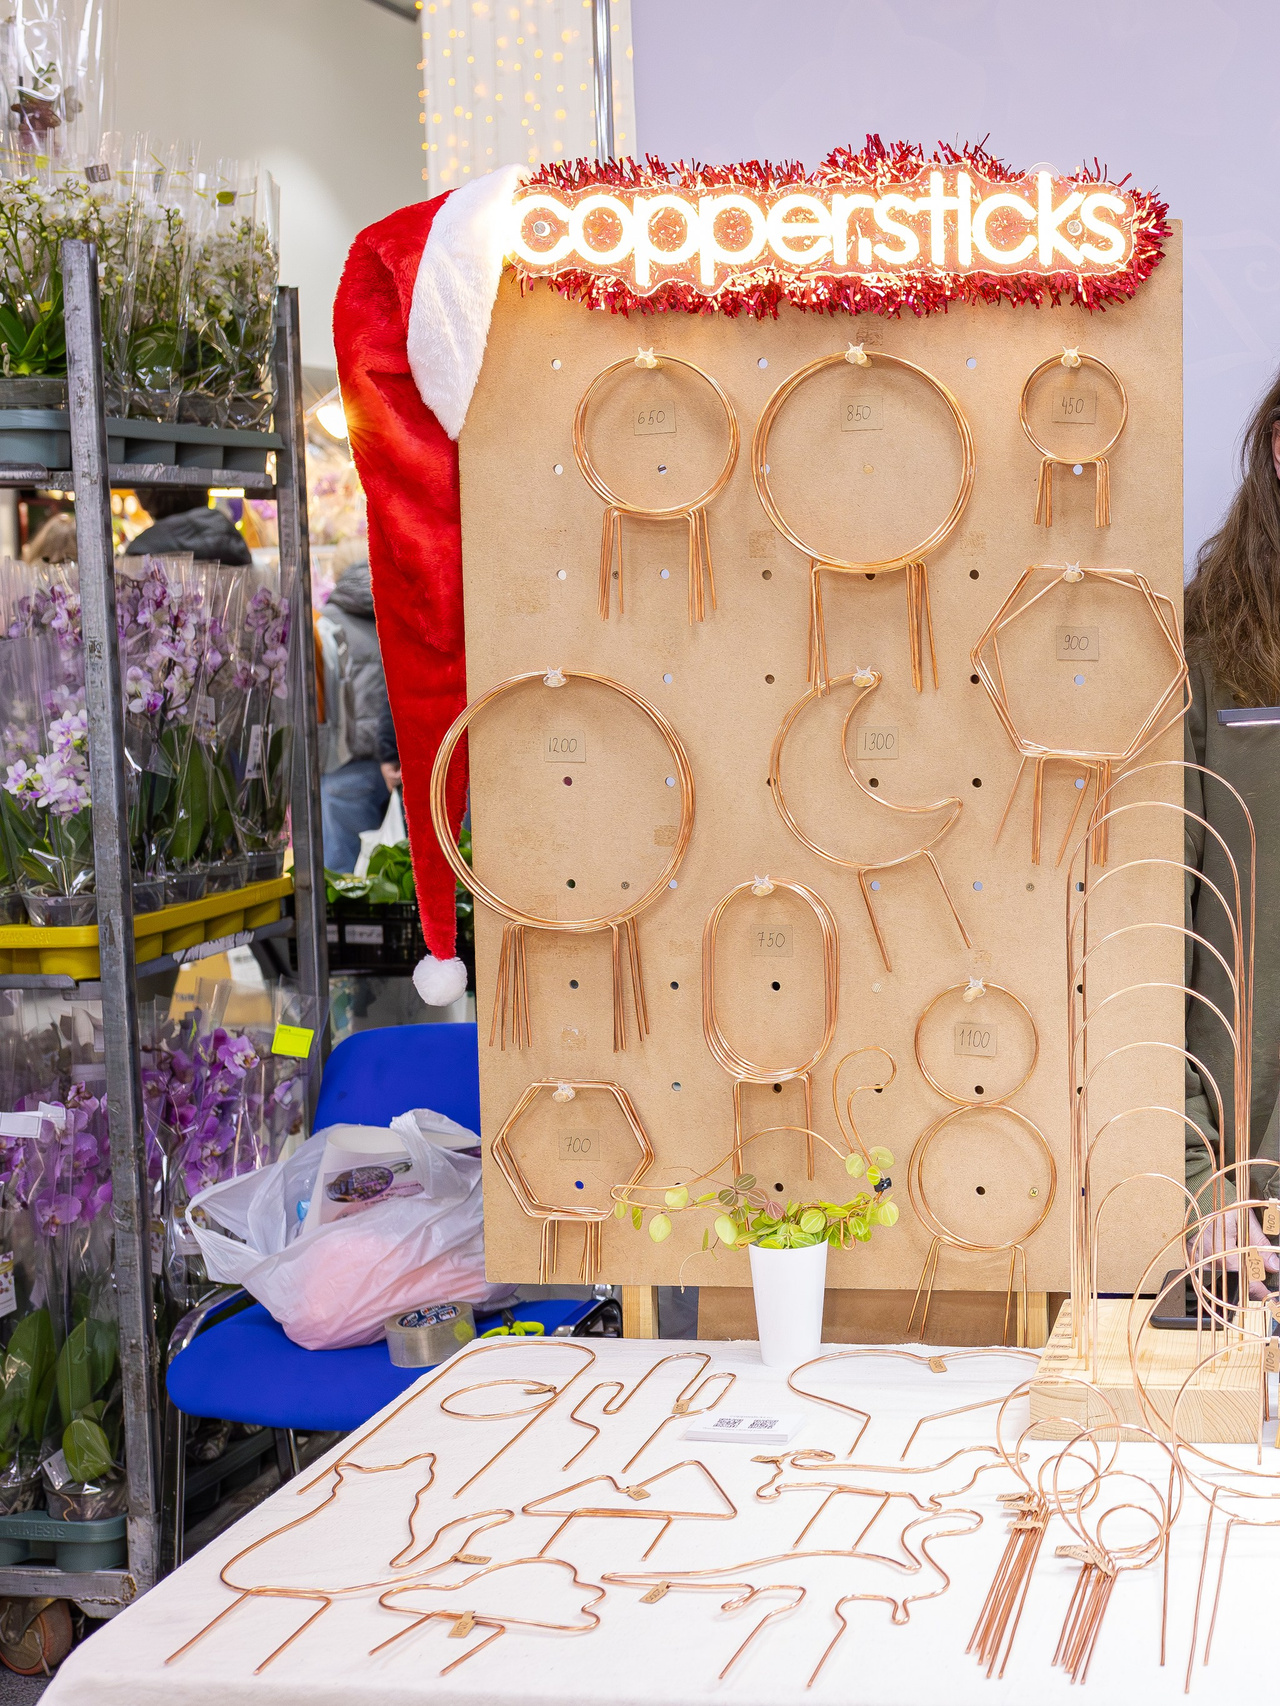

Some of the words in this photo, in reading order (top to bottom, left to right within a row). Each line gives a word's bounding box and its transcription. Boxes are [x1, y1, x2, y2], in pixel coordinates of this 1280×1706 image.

[846, 404, 872, 422] 850
[1061, 397, 1085, 415] 450
[637, 409, 666, 426] 650
[1063, 634, 1089, 651] 900
[548, 736, 578, 754] 1200
[863, 732, 895, 751] 1300
[757, 932, 786, 948] 750
[959, 1029, 991, 1049] 1100
[563, 1136, 592, 1154] 700
[1265, 1213, 1276, 1233] 1400
[1249, 1258, 1262, 1280] 1200
[1265, 1351, 1276, 1372] 1100
